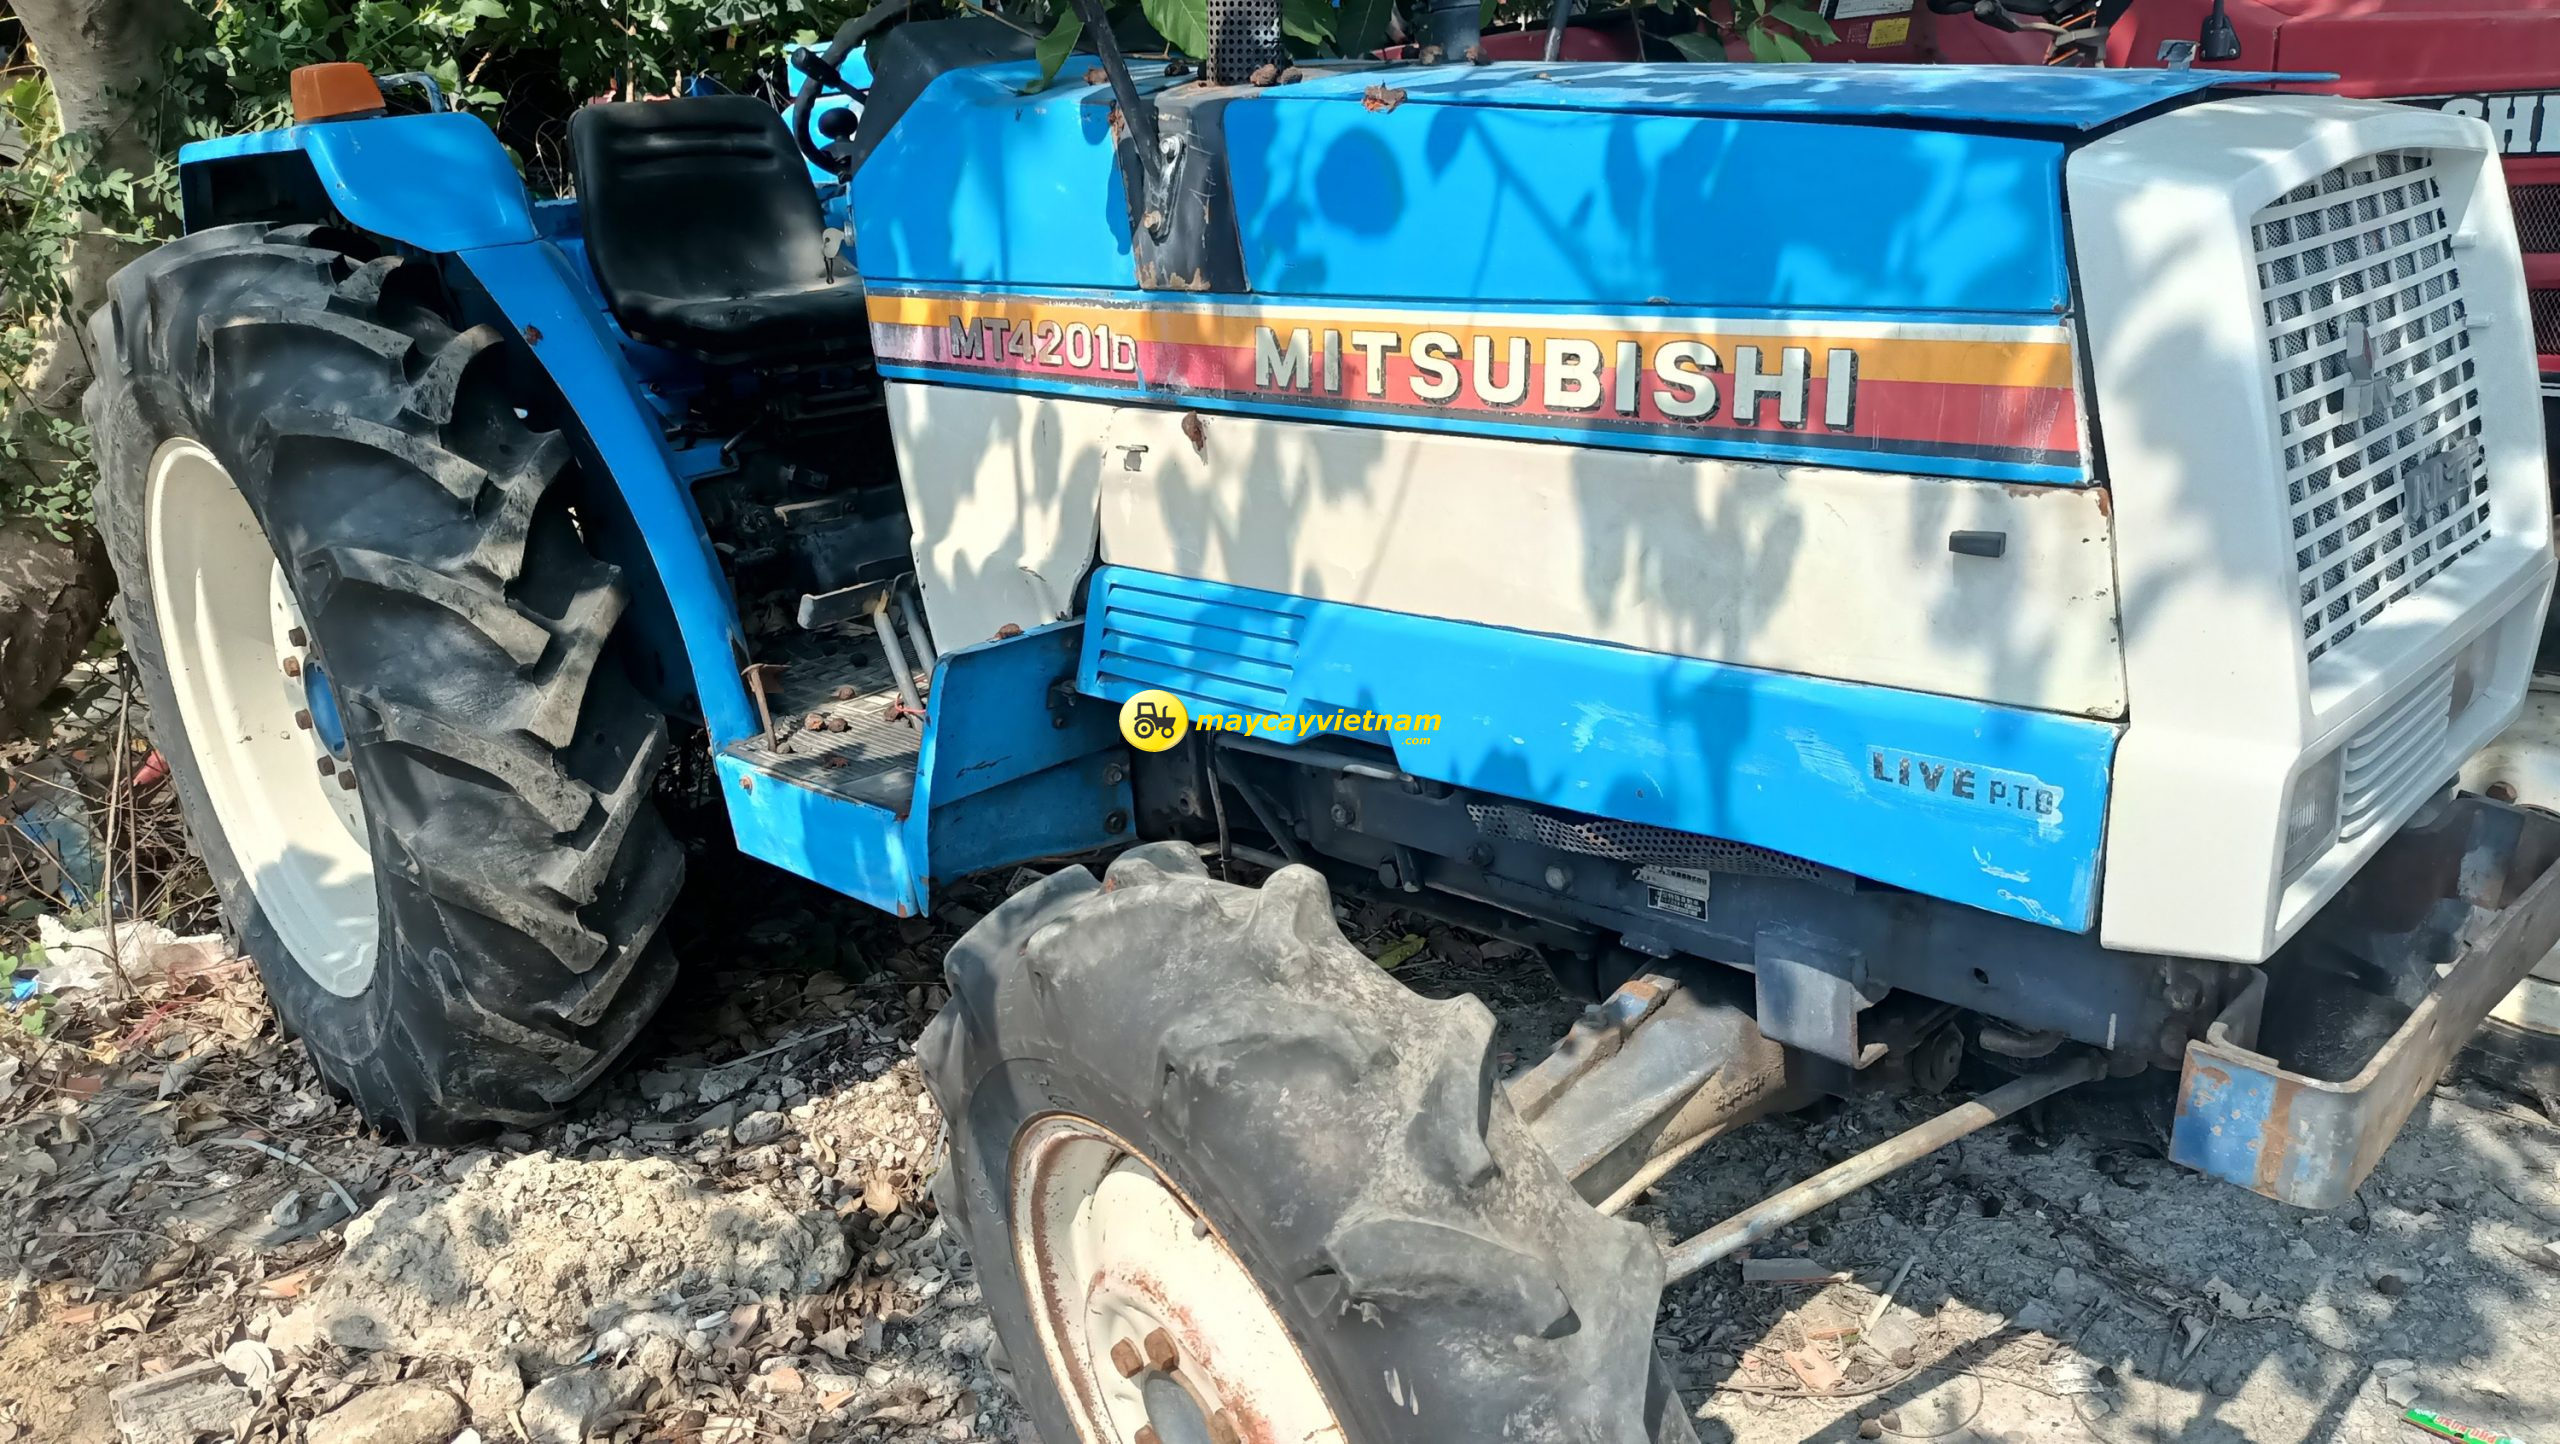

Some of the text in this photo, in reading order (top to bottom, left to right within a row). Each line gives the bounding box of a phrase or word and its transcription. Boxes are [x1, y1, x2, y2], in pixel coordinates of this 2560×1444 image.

[949, 315, 1138, 373] MT4201D
[1254, 325, 1859, 433] MITSUBISHI
[1872, 752, 1975, 800] LIVE
